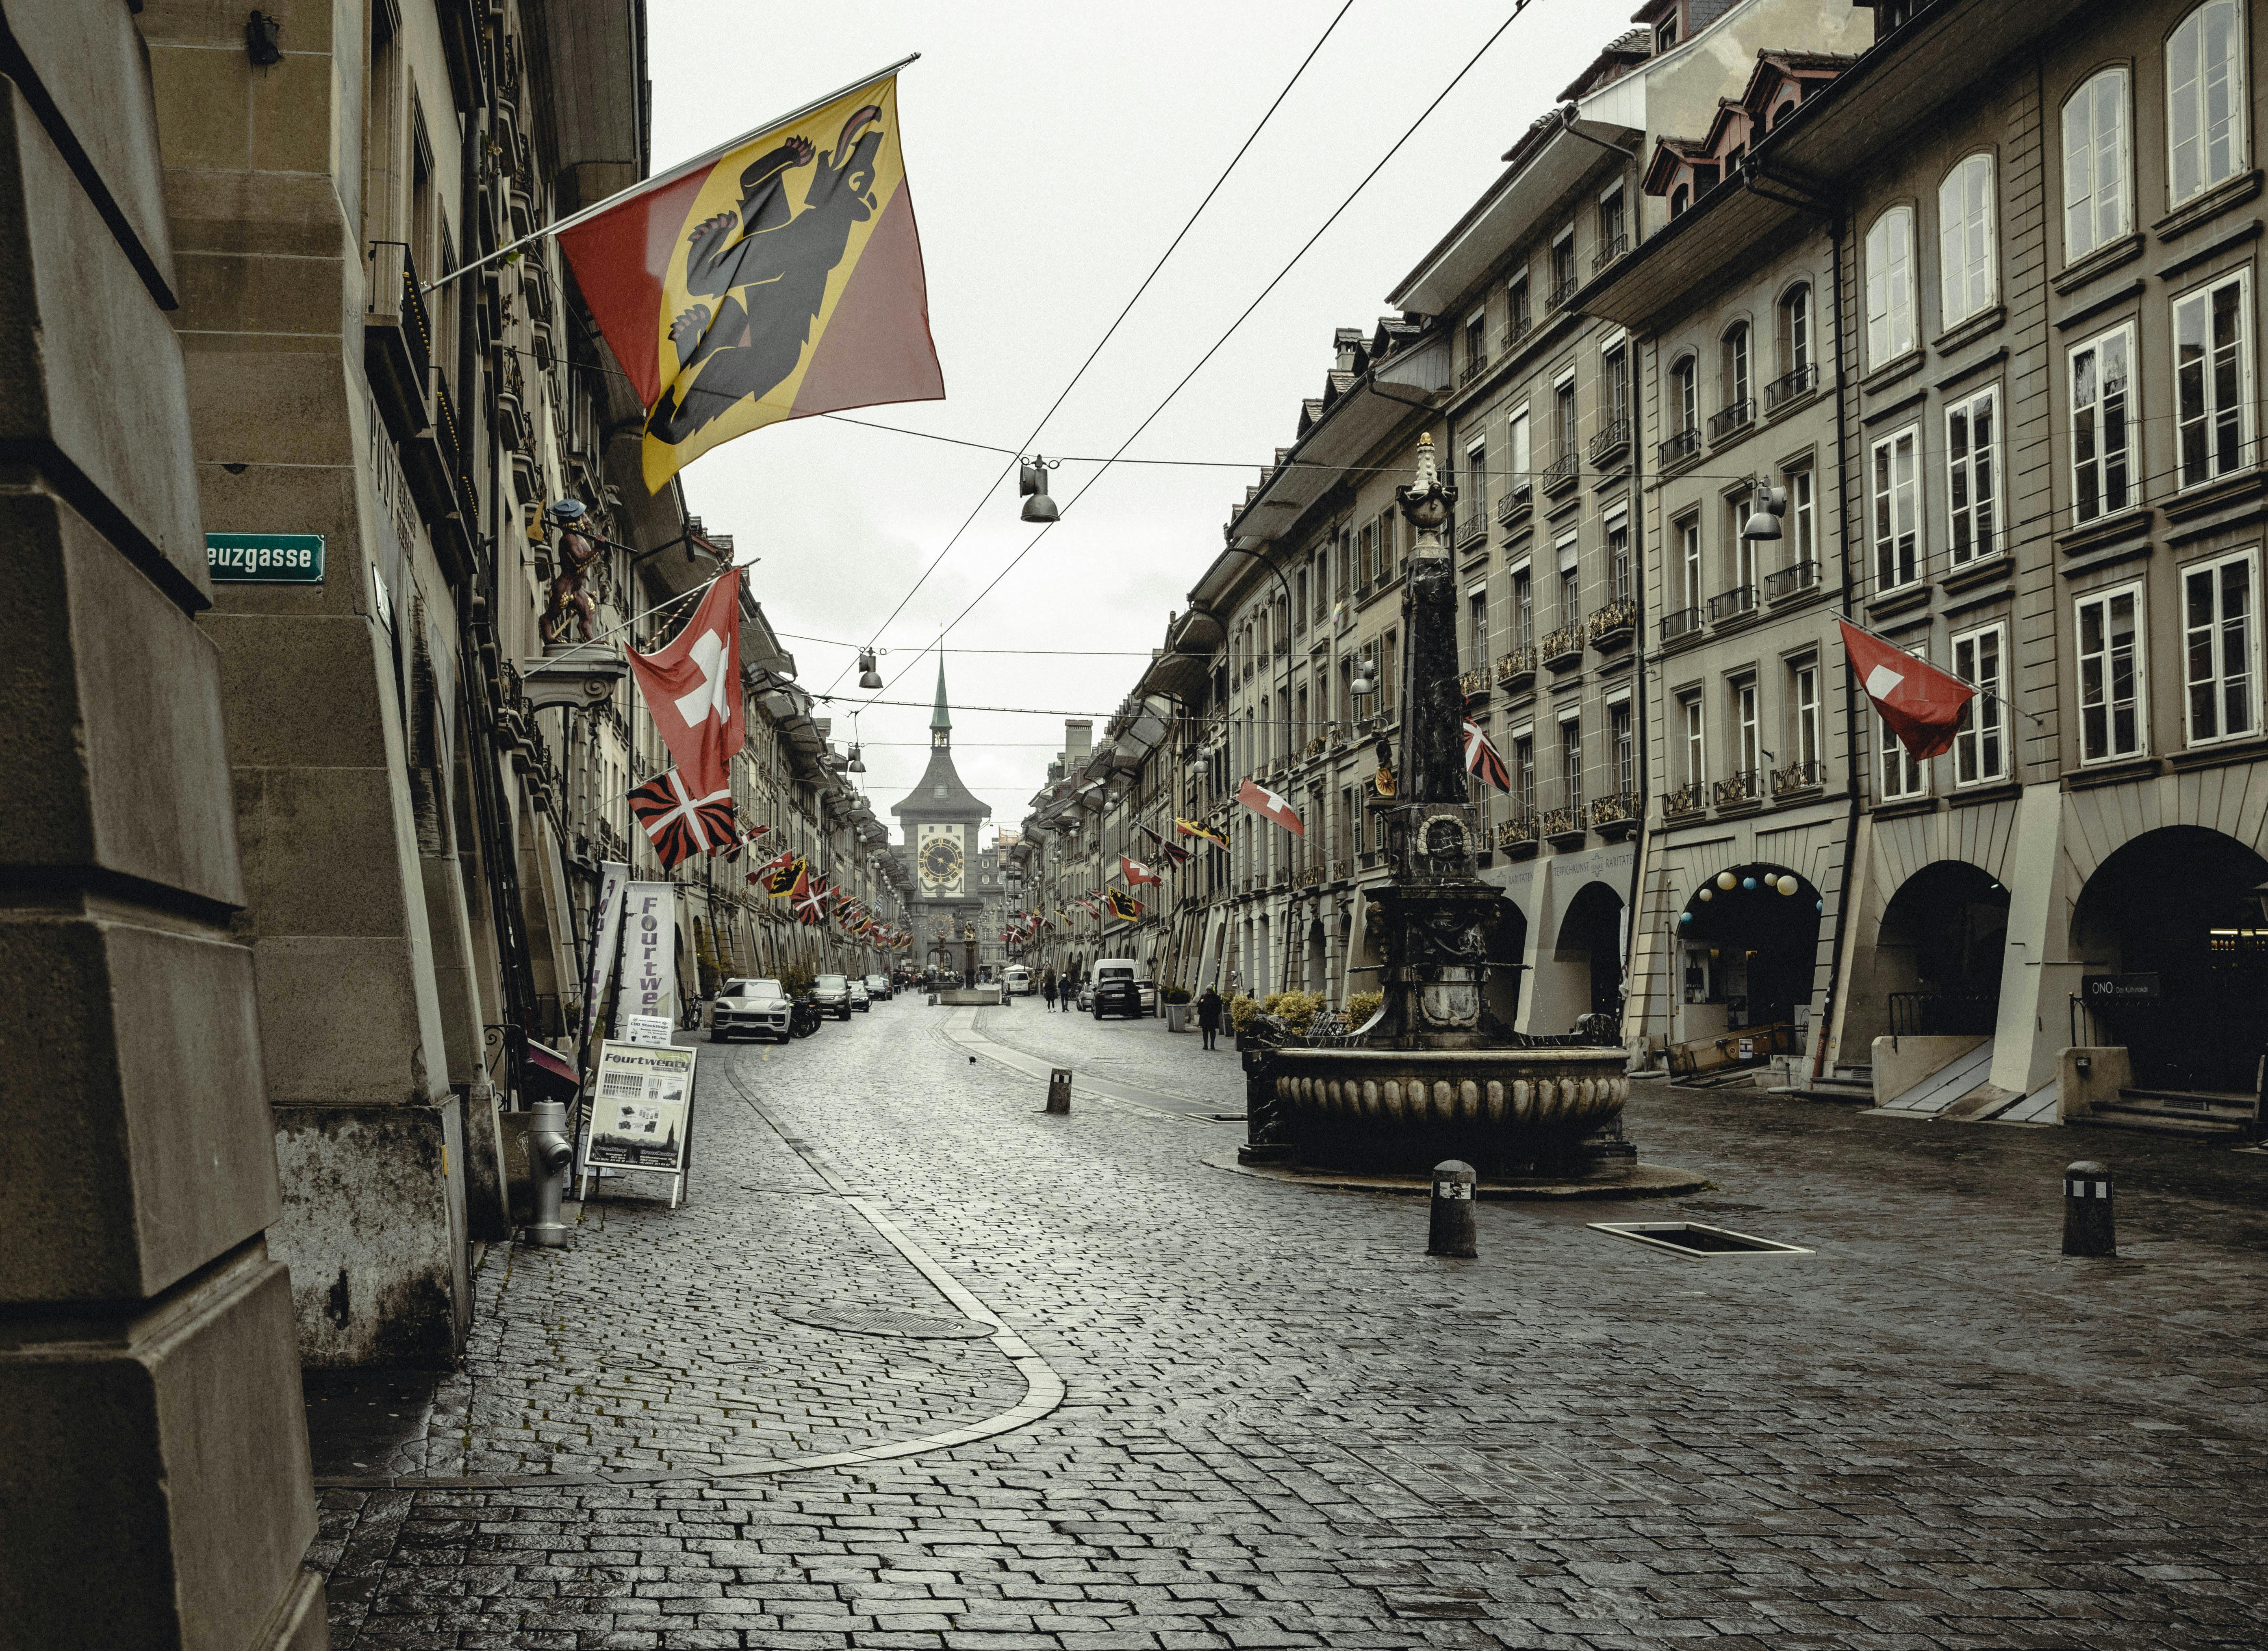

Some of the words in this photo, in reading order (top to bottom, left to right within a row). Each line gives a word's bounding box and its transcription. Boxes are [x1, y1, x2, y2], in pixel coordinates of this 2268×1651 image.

[1554, 862, 1589, 877] TEPPICHKUNST
[2092, 982, 2113, 994] ONO
[605, 1053, 690, 1072] Fourtwenty
